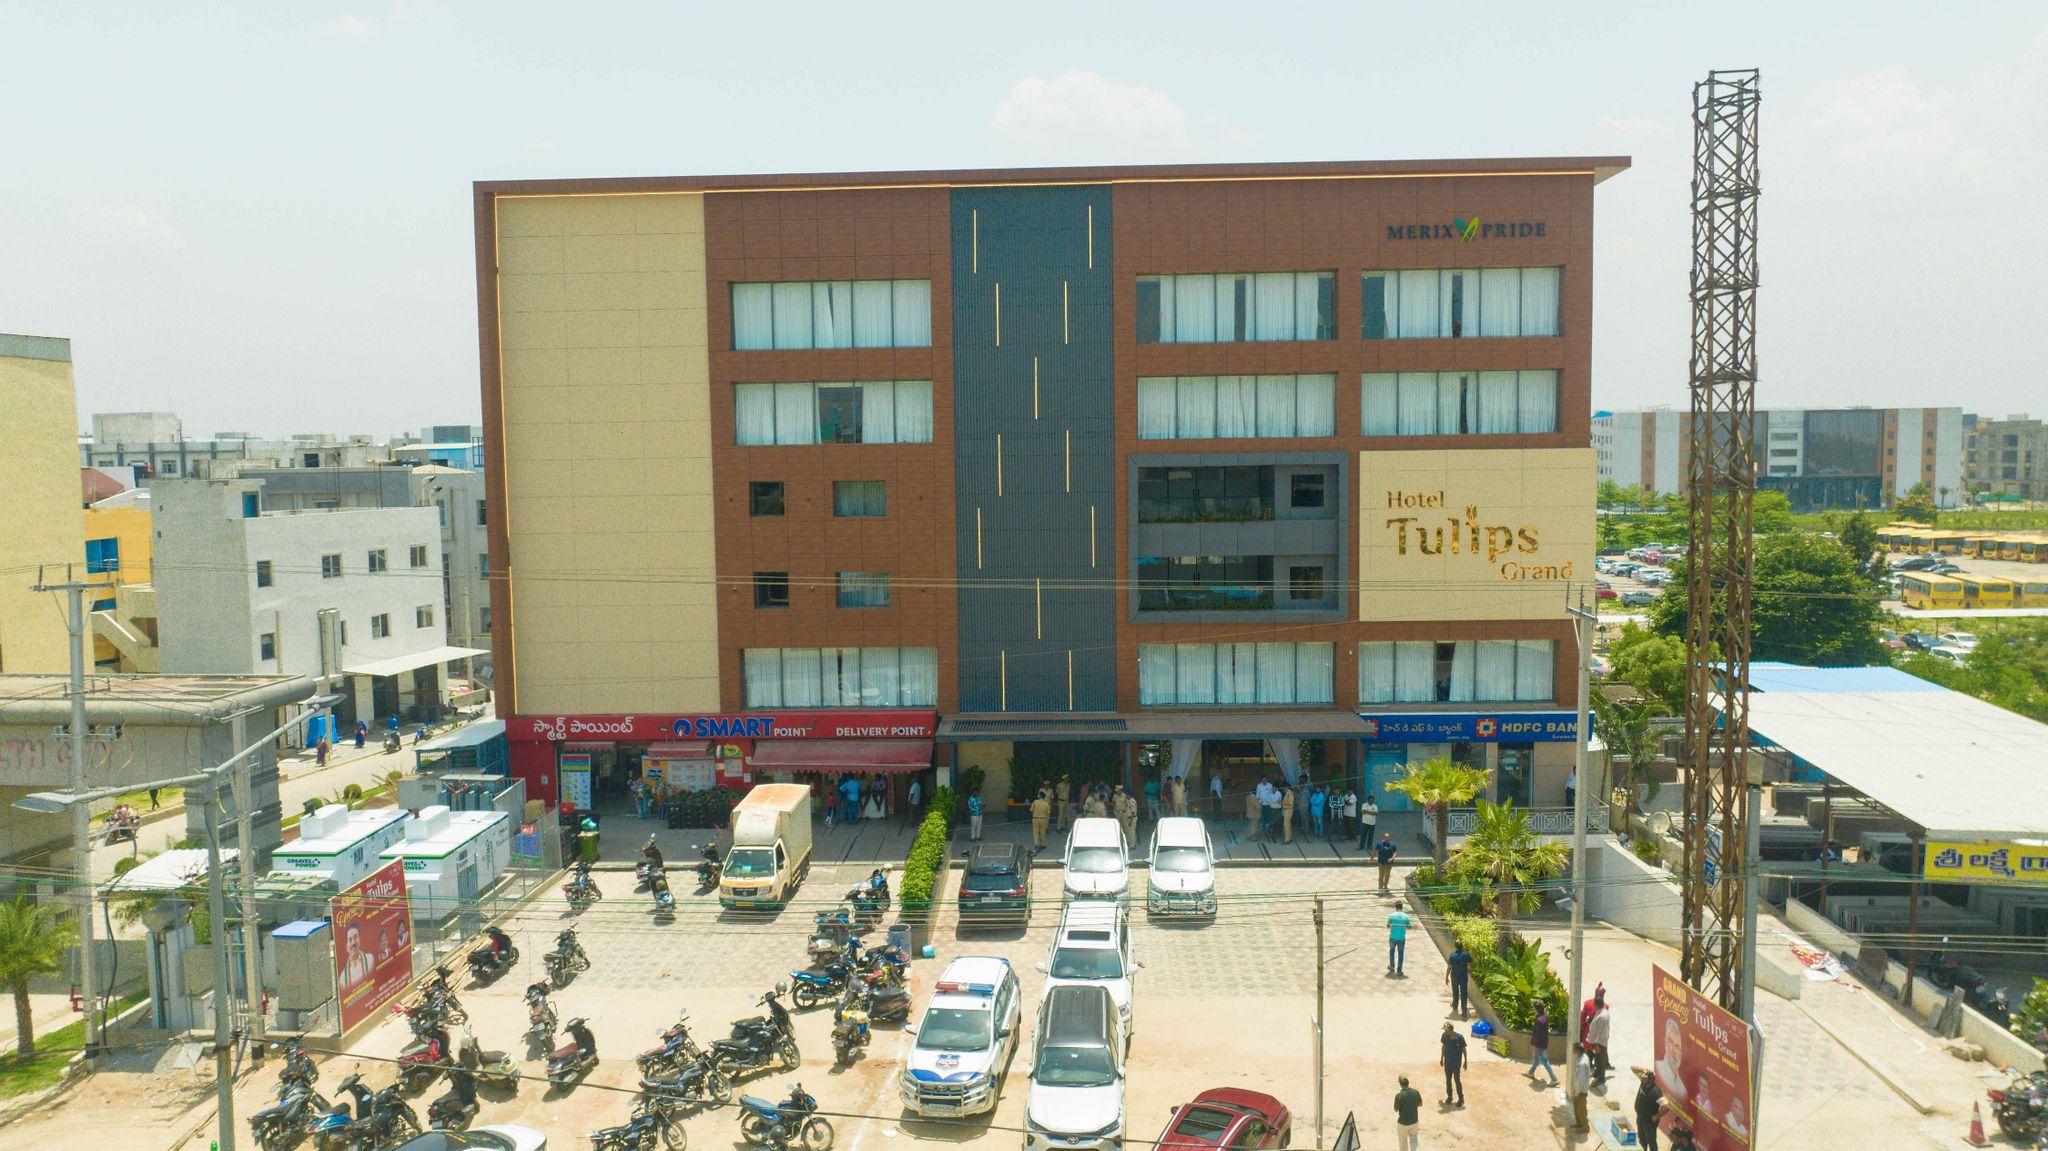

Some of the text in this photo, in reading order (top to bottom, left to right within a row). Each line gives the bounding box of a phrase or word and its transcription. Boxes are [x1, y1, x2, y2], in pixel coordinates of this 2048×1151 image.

[1387, 222, 1547, 240] MERIX PRIDE
[1387, 490, 1445, 508] Hotel
[1386, 503, 1539, 564] Tulips
[1501, 561, 1573, 580] Grand
[570, 716, 634, 733] పాయింట్
[695, 716, 811, 737] SMART POINT
[836, 726, 925, 737] DELIVERY POINT
[1502, 722, 1577, 732] HDFC BAN
[367, 880, 393, 901] Tulips
[1693, 1007, 1729, 1044] Tulips
